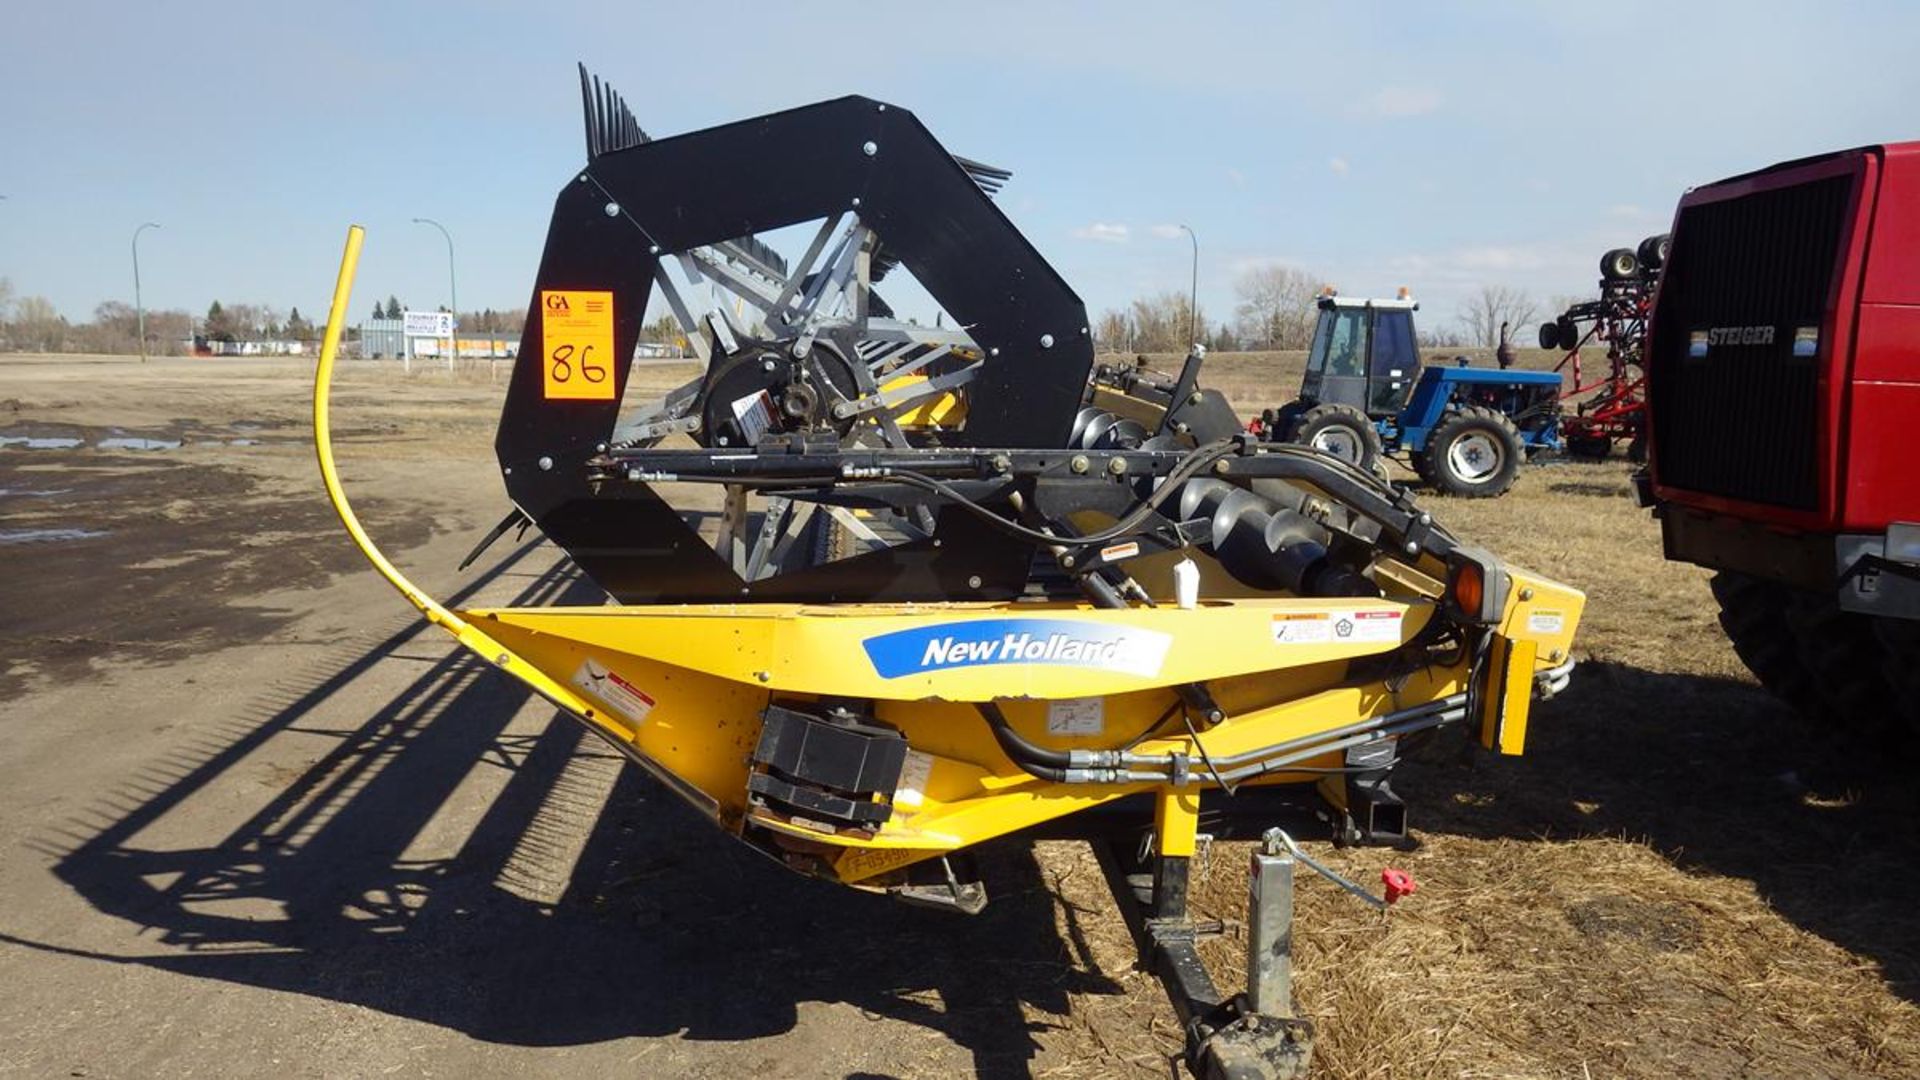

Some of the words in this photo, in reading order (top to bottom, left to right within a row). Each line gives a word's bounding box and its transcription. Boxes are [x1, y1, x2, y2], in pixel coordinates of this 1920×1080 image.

[546, 294, 570, 310] GA
[1709, 325, 1776, 346] STEIGER
[551, 344, 606, 384] 86
[920, 637, 999, 666] New
[998, 632, 1126, 662] Holland
